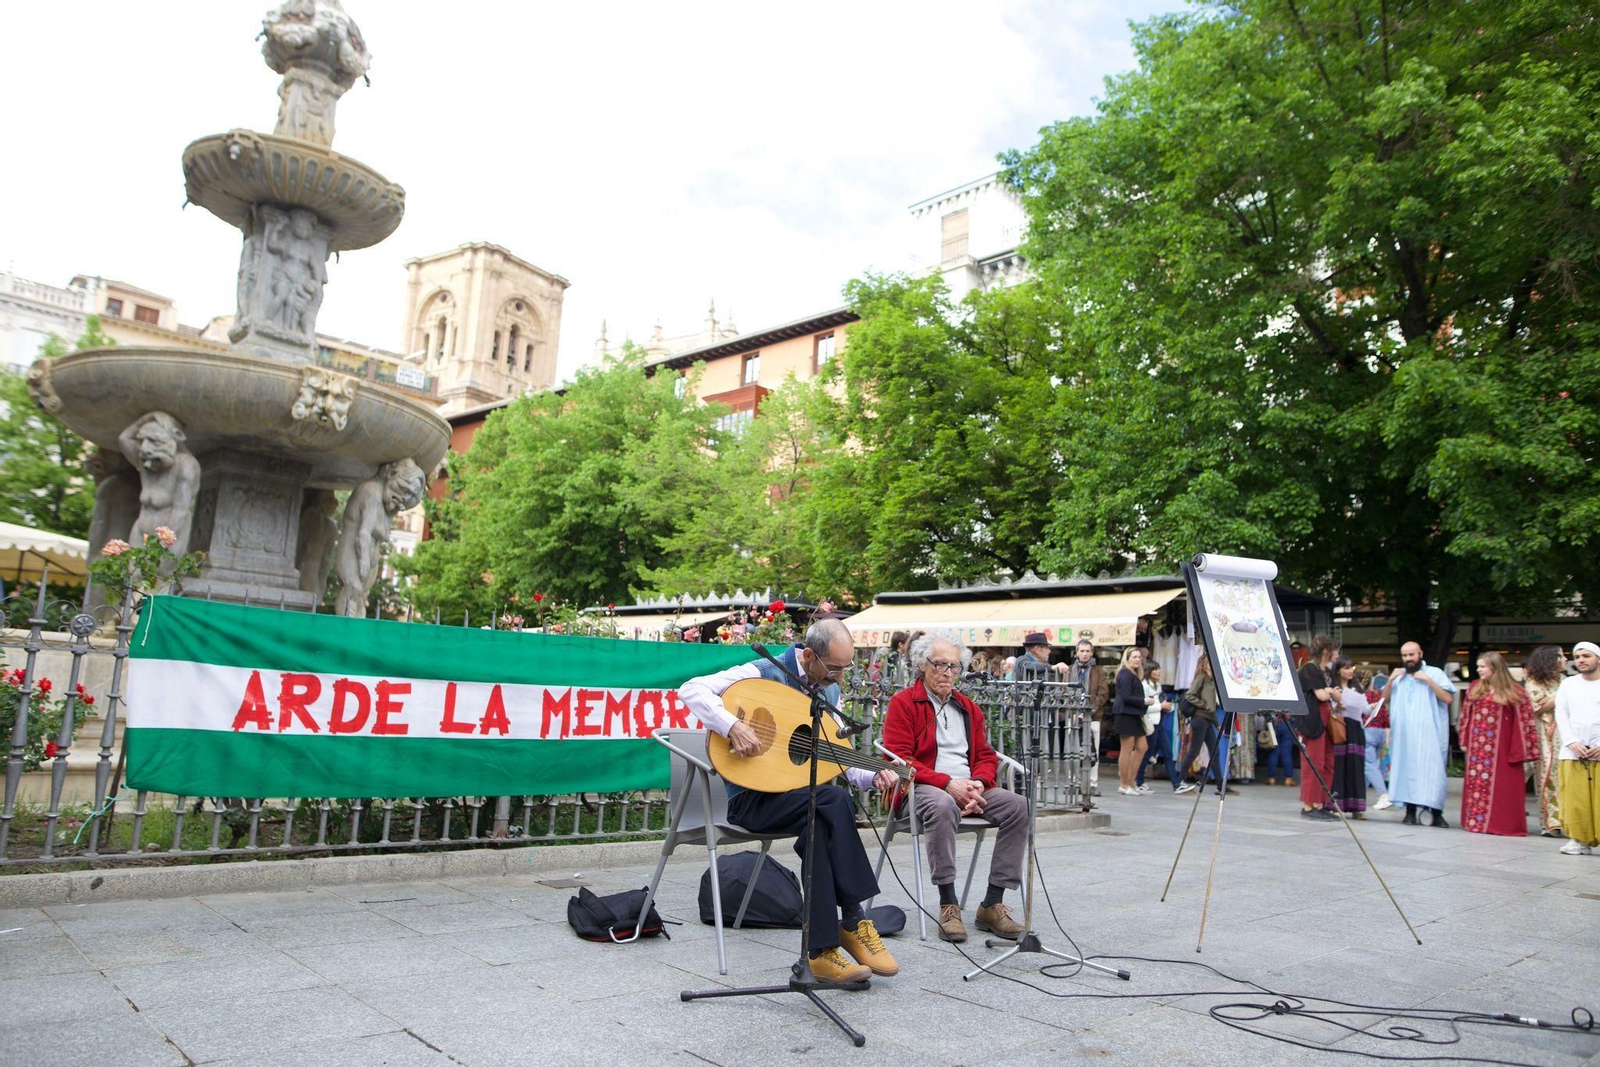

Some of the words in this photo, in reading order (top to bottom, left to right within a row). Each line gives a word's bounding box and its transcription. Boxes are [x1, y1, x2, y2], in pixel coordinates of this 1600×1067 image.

[231, 670, 412, 734] ARDE
[439, 681, 511, 736] LA
[540, 686, 705, 741] MEMOR
